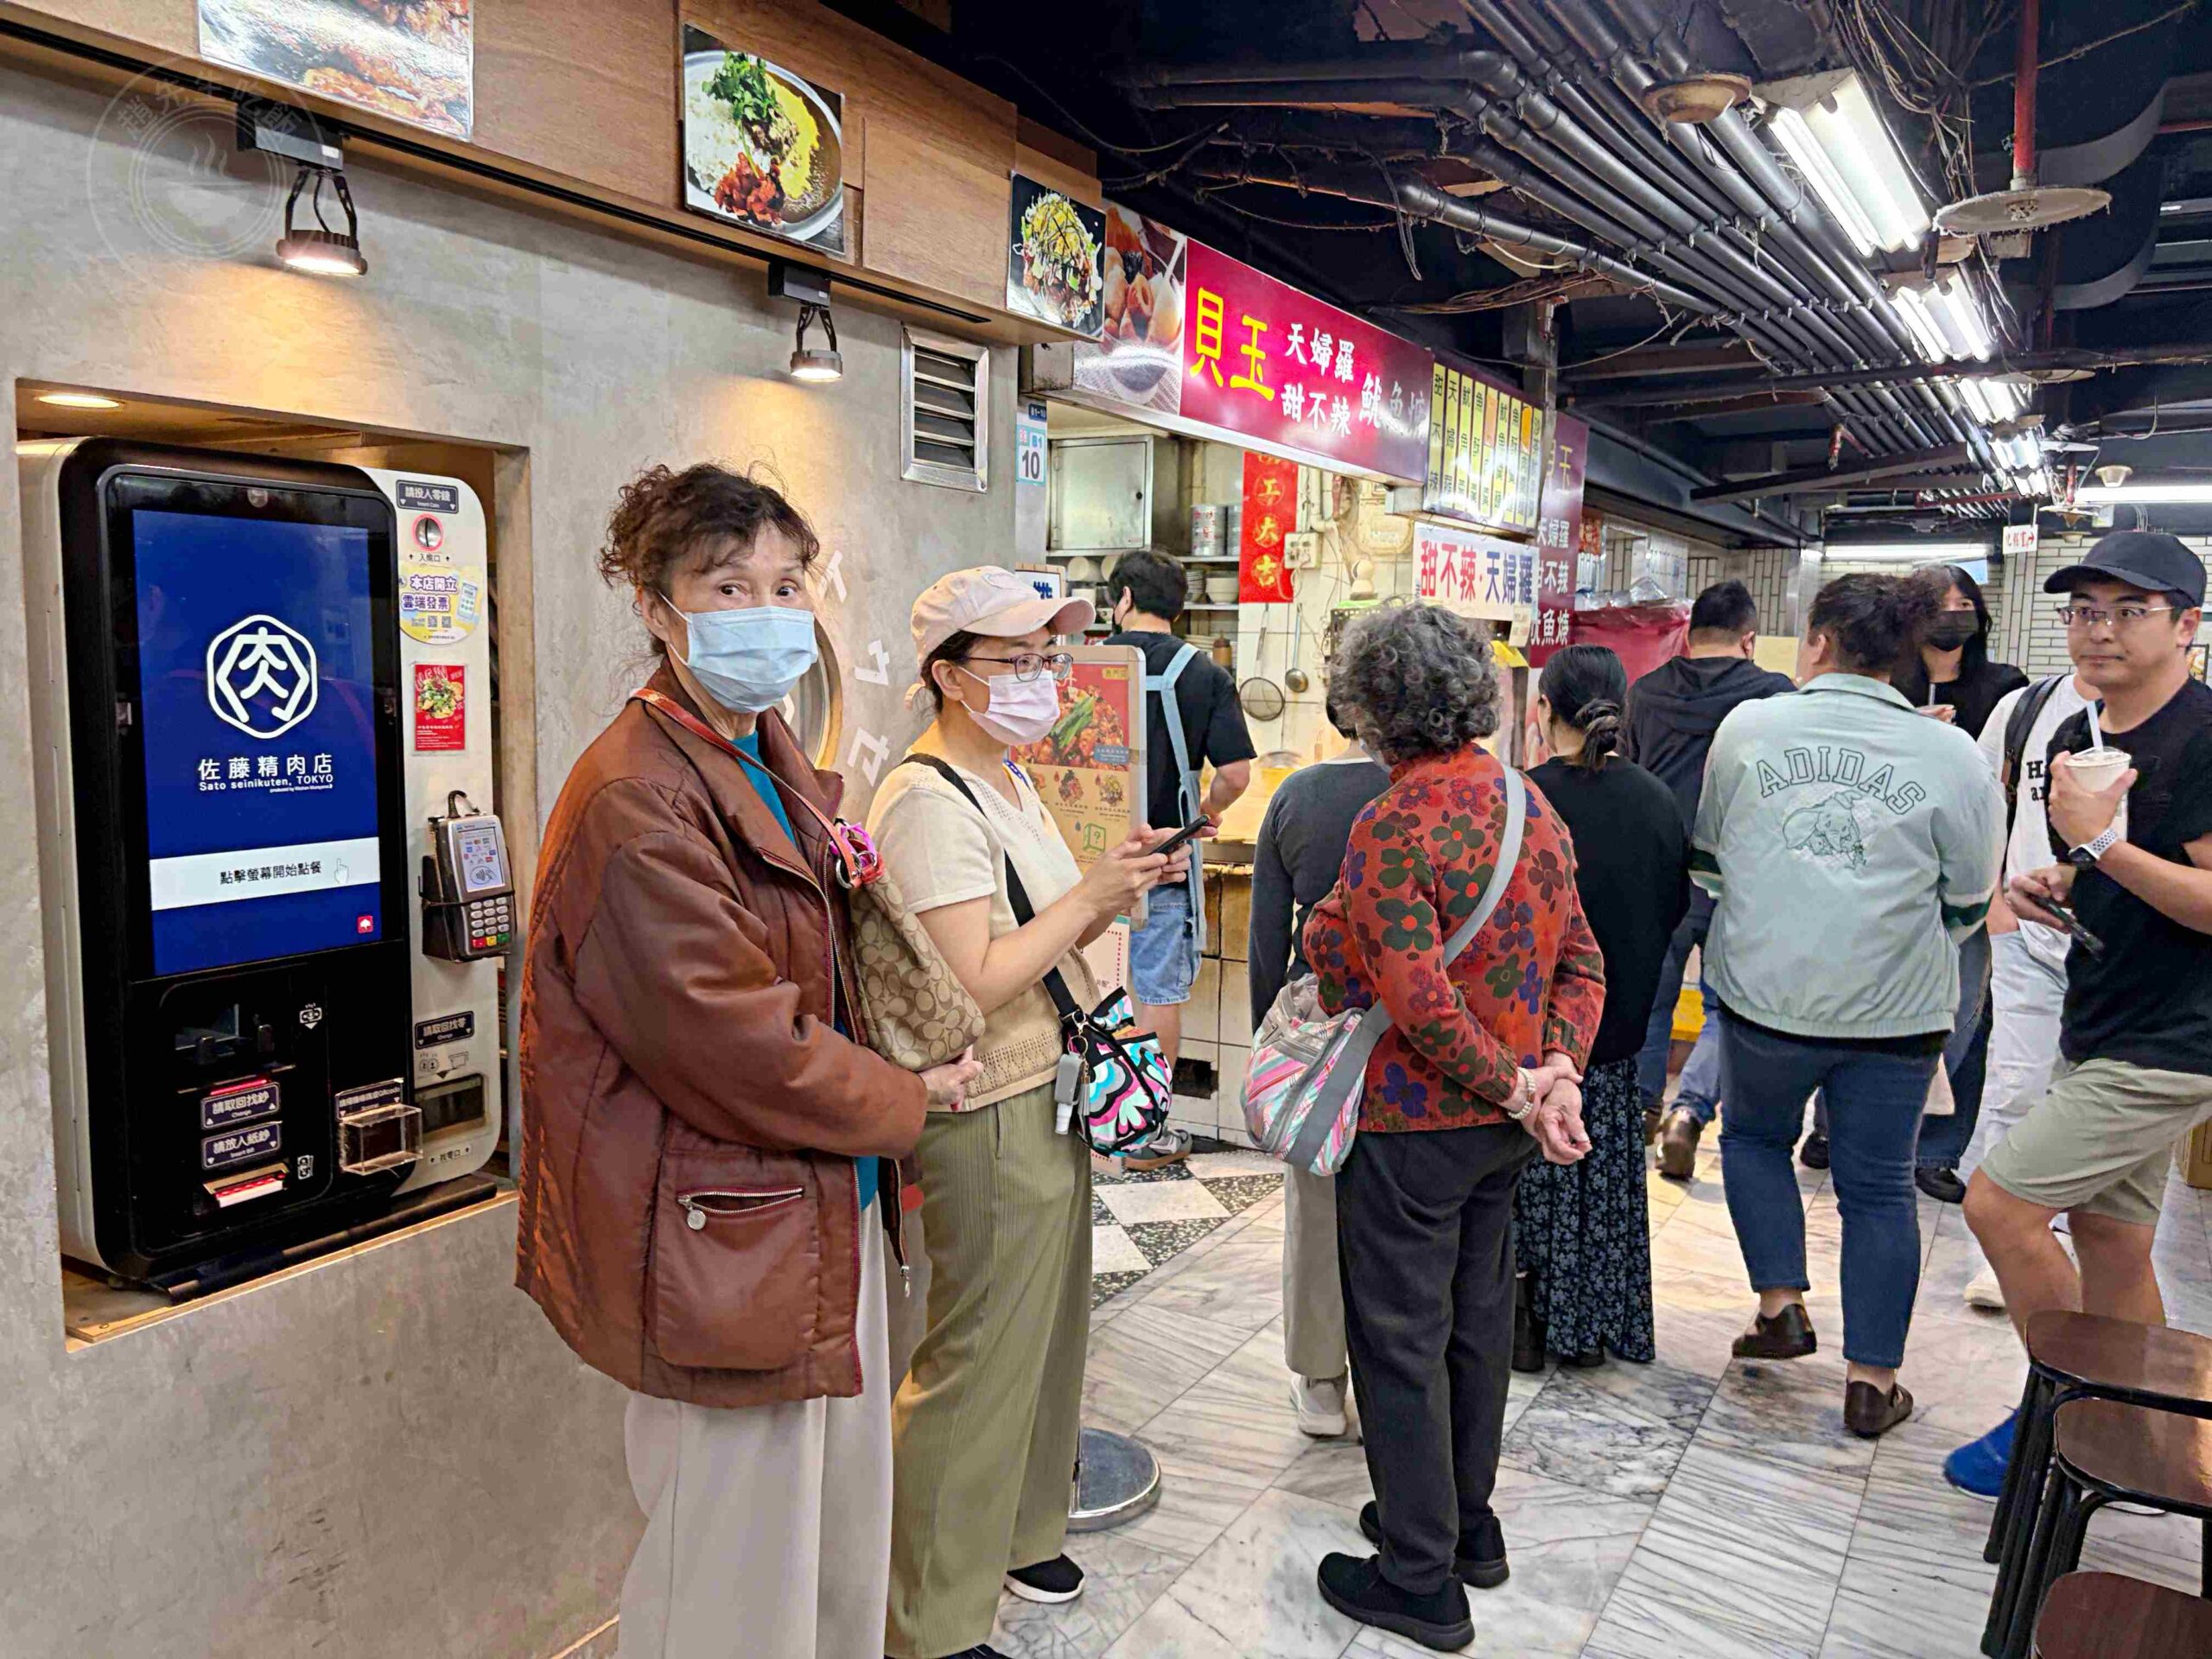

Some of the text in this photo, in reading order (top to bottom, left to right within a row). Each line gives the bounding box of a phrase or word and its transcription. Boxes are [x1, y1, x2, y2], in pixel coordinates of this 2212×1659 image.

[1189, 287, 1275, 402] 貝玉
[1285, 323, 1355, 383] 天婦羅
[1281, 383, 1351, 438] 甜不辣
[1022, 449, 1040, 480] 10
[410, 575, 457, 592] 本店開立
[1538, 560, 1569, 594] 不辣
[402, 594, 448, 610] 雲端發票
[197, 752, 333, 781] 佐藤精肉店
[199, 781, 226, 791] Sato
[296, 773, 334, 785] TOKYO
[1756, 746, 1926, 815] ADIDAS
[219, 861, 322, 885] 點擊螢幕開始點餐
